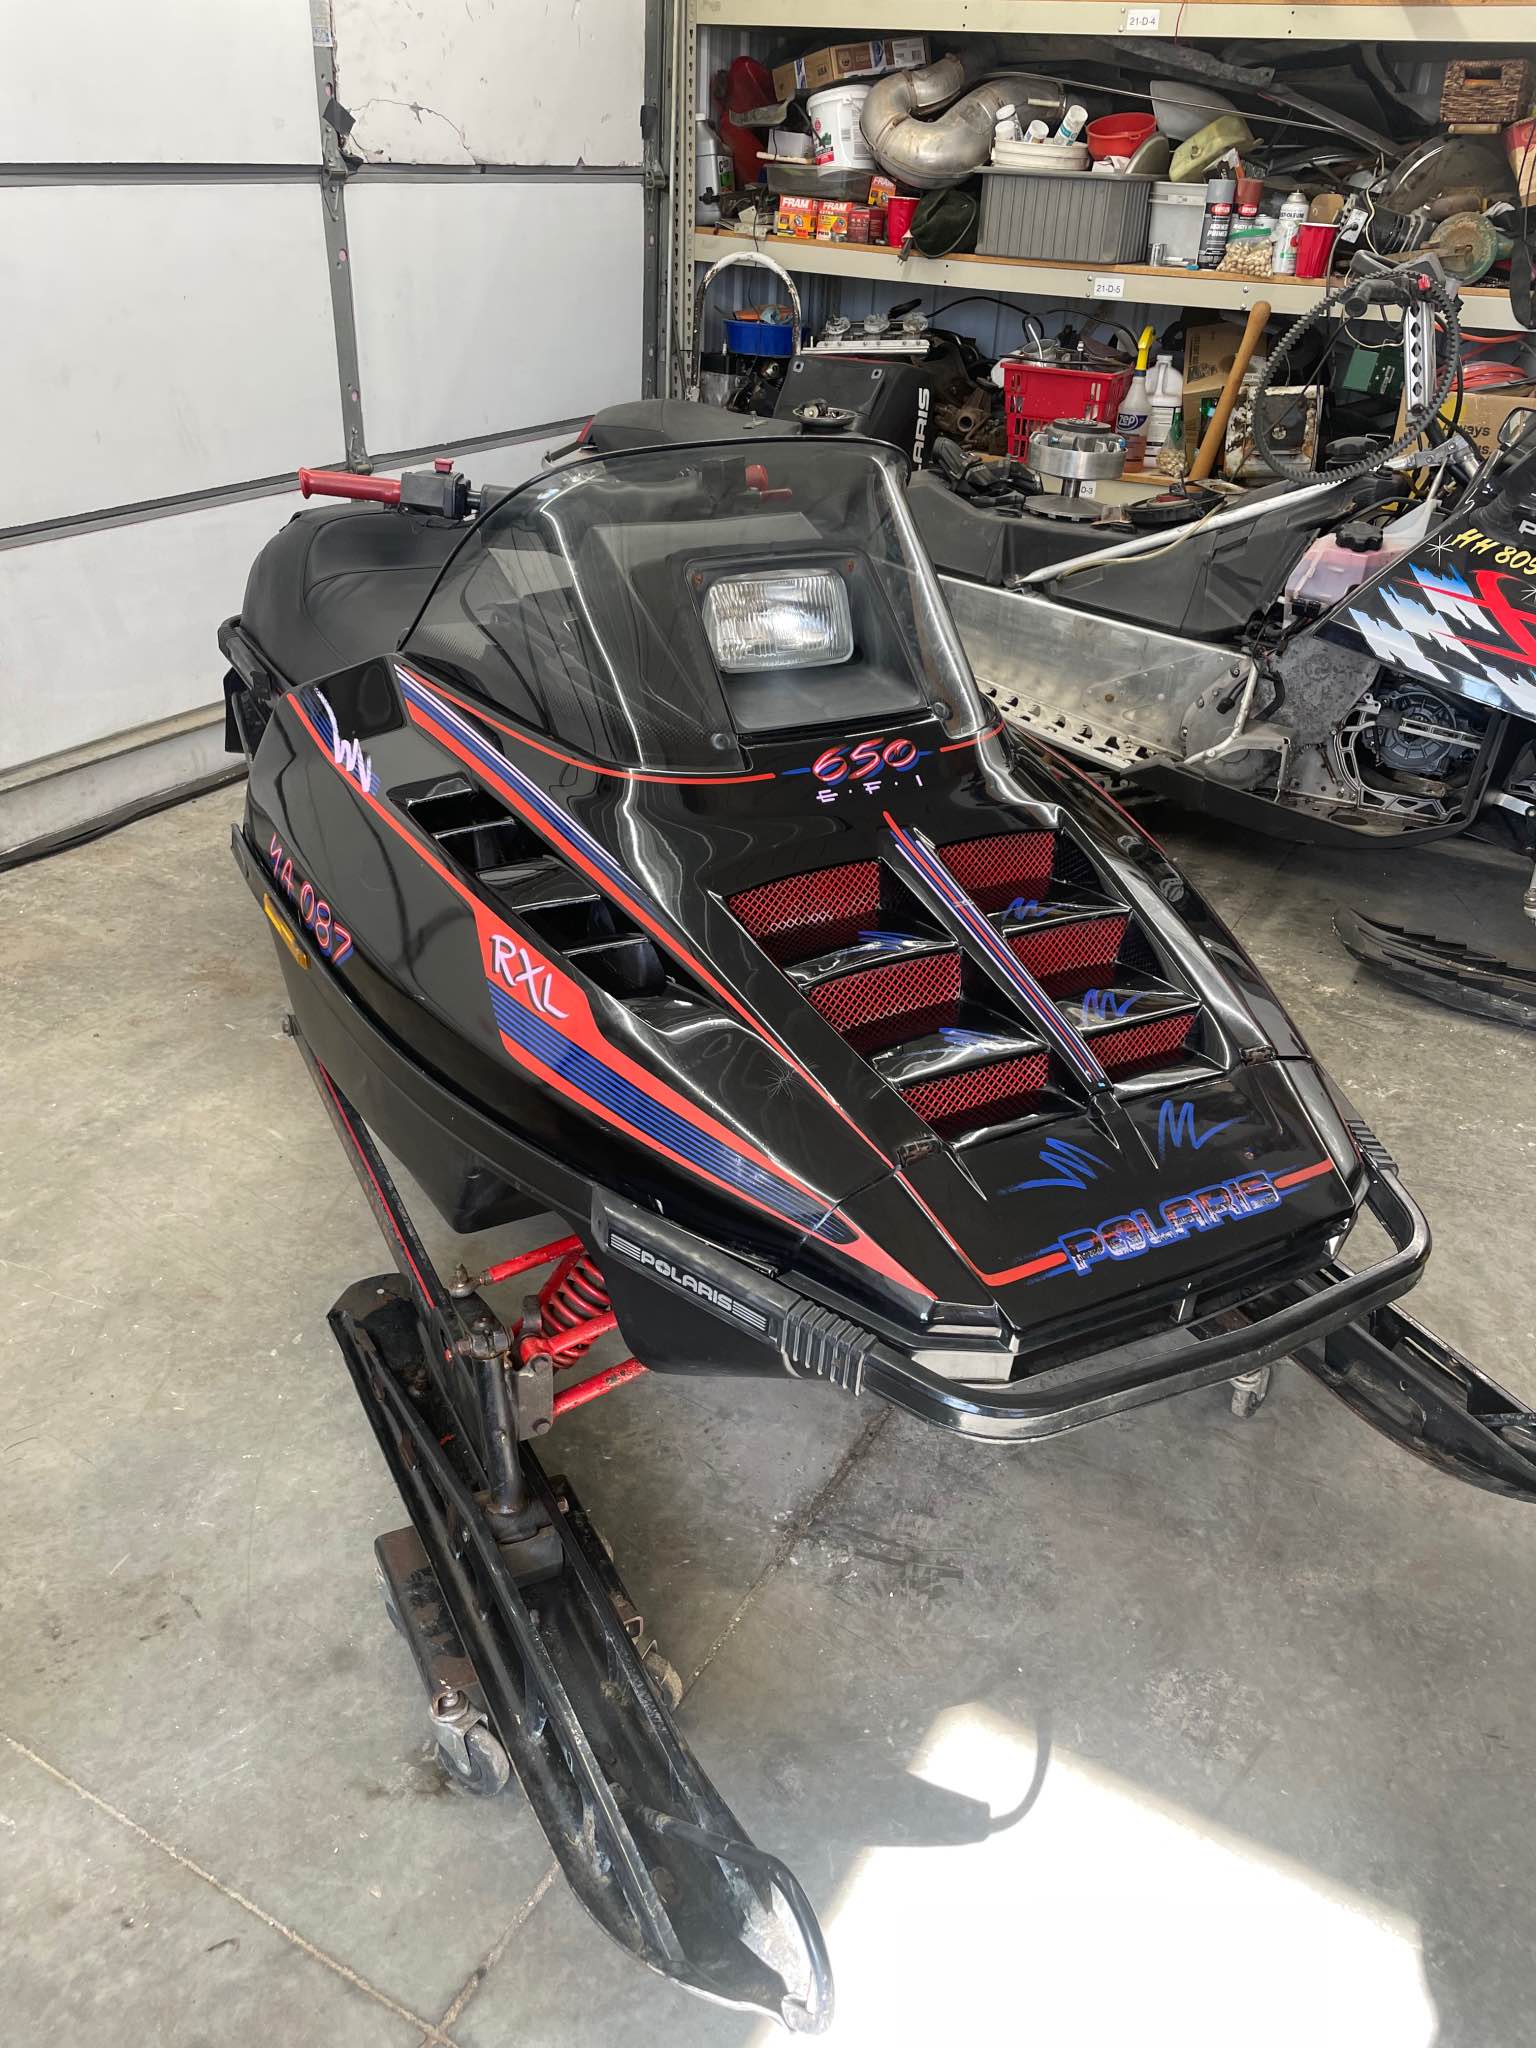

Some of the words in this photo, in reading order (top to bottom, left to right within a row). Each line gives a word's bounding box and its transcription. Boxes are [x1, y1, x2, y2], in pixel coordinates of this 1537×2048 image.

[1129, 16, 1156, 27] 21-D-4
[781, 196, 809, 208] FRAM
[822, 201, 848, 212] FRAM
[1096, 284, 1121, 294] 21-D-5
[912, 386, 930, 471] ARIS
[1450, 527, 1500, 555] HH
[811, 737, 921, 786] 650
[300, 880, 355, 967] 087
[489, 934, 569, 1019] RXL
[1058, 1169, 1282, 1277] POLARIS
[640, 1250, 733, 1312] POLARIS
